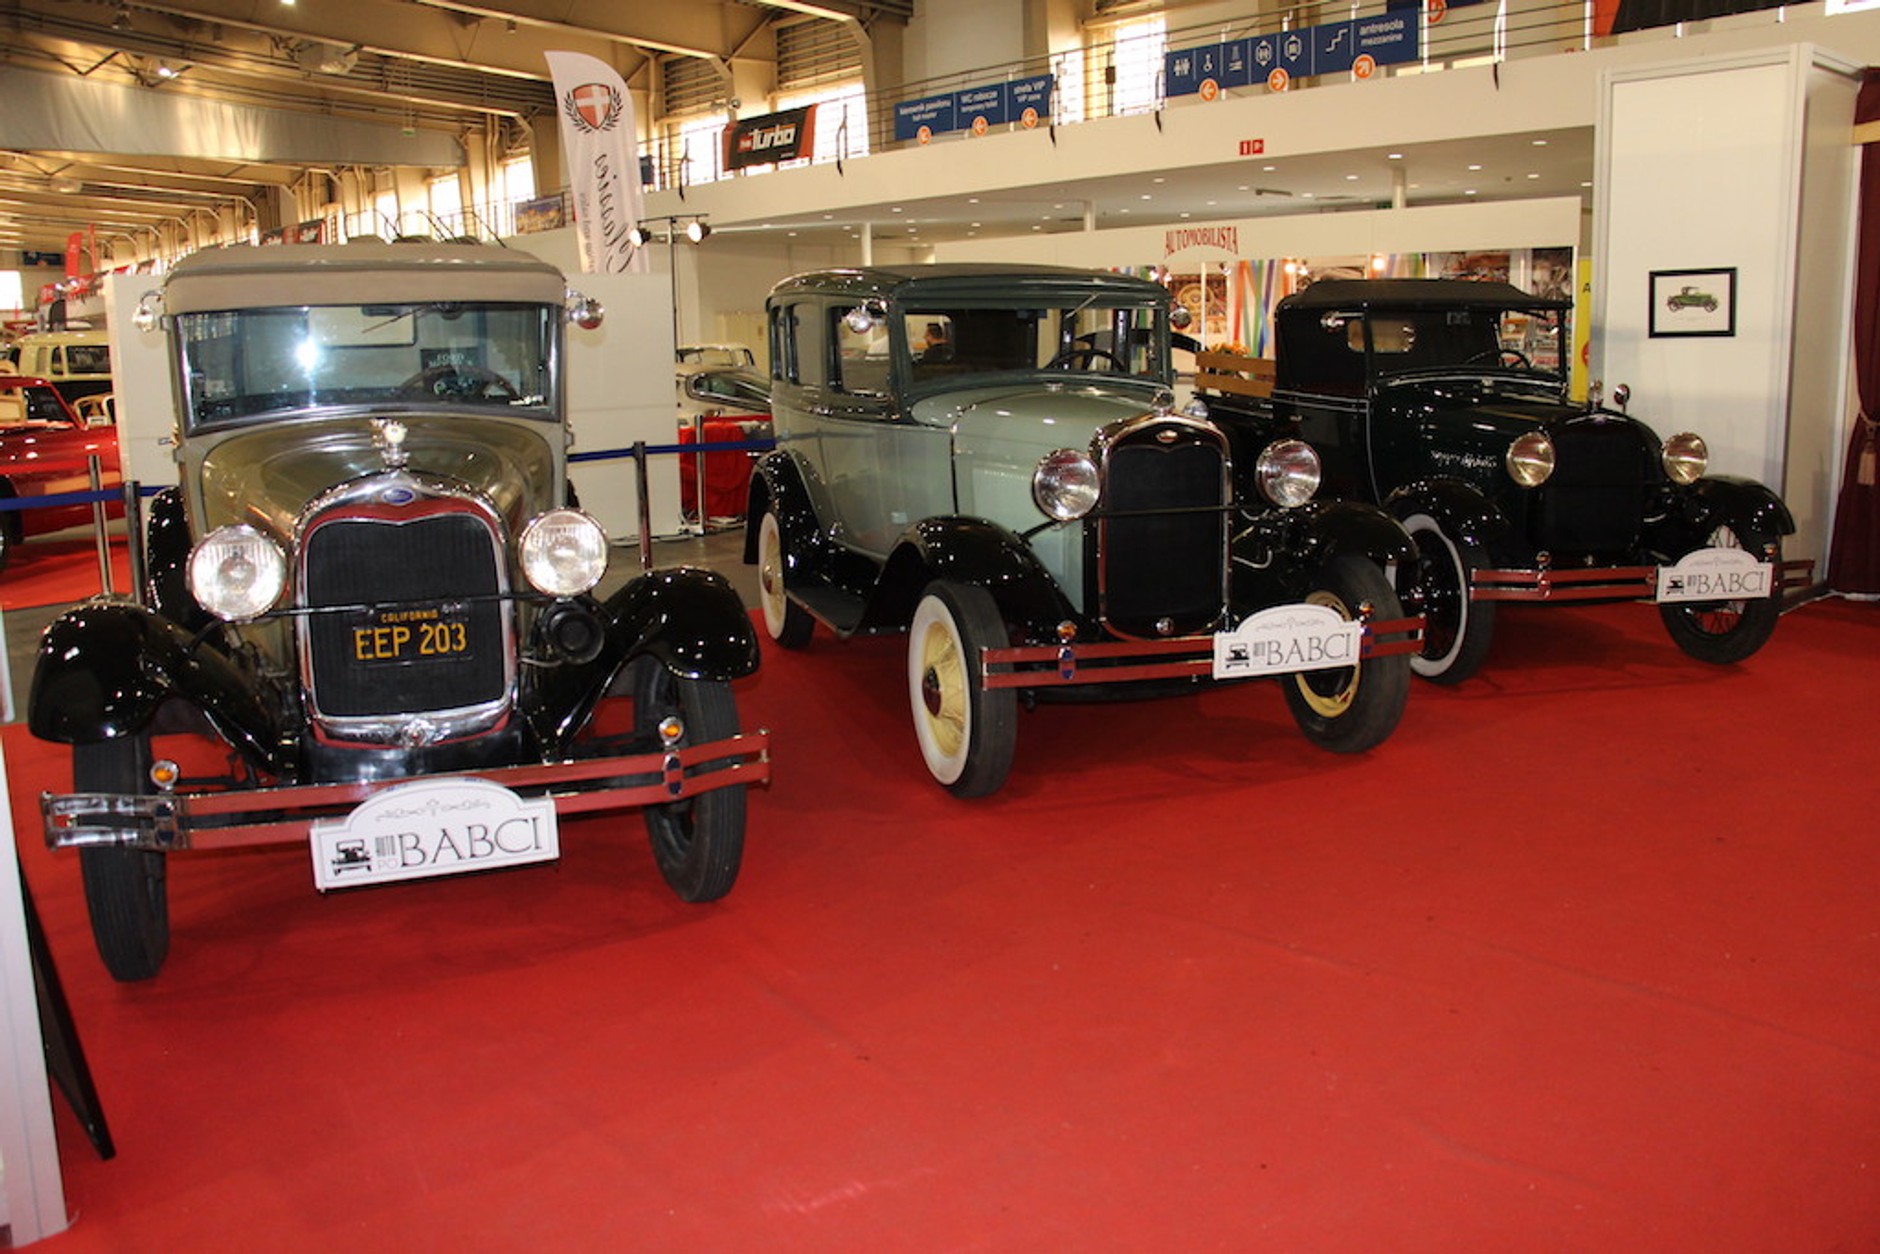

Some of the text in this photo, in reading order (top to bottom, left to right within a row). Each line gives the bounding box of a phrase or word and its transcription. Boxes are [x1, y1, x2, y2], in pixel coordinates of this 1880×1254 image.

[1359, 19, 1404, 36] antresola
[1361, 33, 1403, 47] mezzanine
[748, 124, 796, 150] turbo
[1164, 226, 1239, 260] AUTOMOBILISTA
[1696, 571, 1764, 595] BABCI
[380, 609, 439, 624] CALIFORNIA
[354, 623, 468, 661] EEP 203
[1266, 633, 1350, 667] BABCI
[398, 817, 544, 869] BABCI
